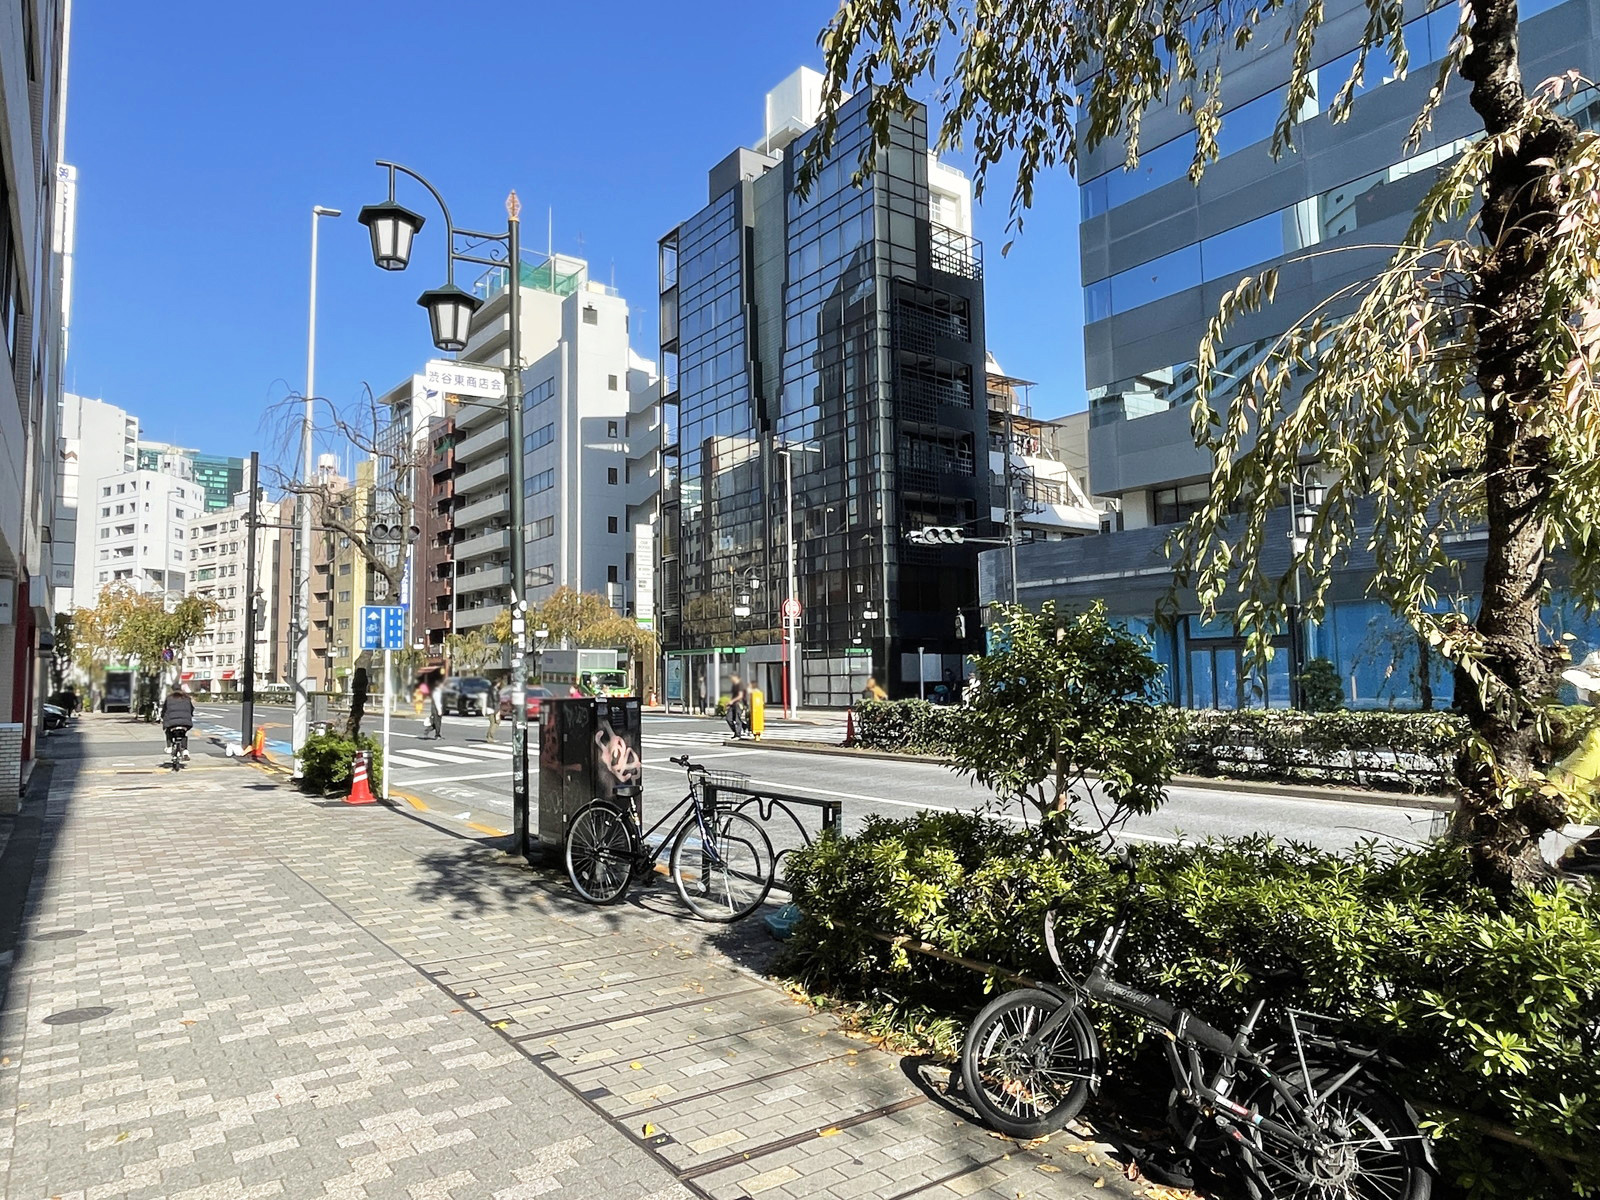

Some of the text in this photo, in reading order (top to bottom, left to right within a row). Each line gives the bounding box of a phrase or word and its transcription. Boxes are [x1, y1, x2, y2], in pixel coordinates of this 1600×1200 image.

[428, 370, 502, 391] 渋谷東商店会
